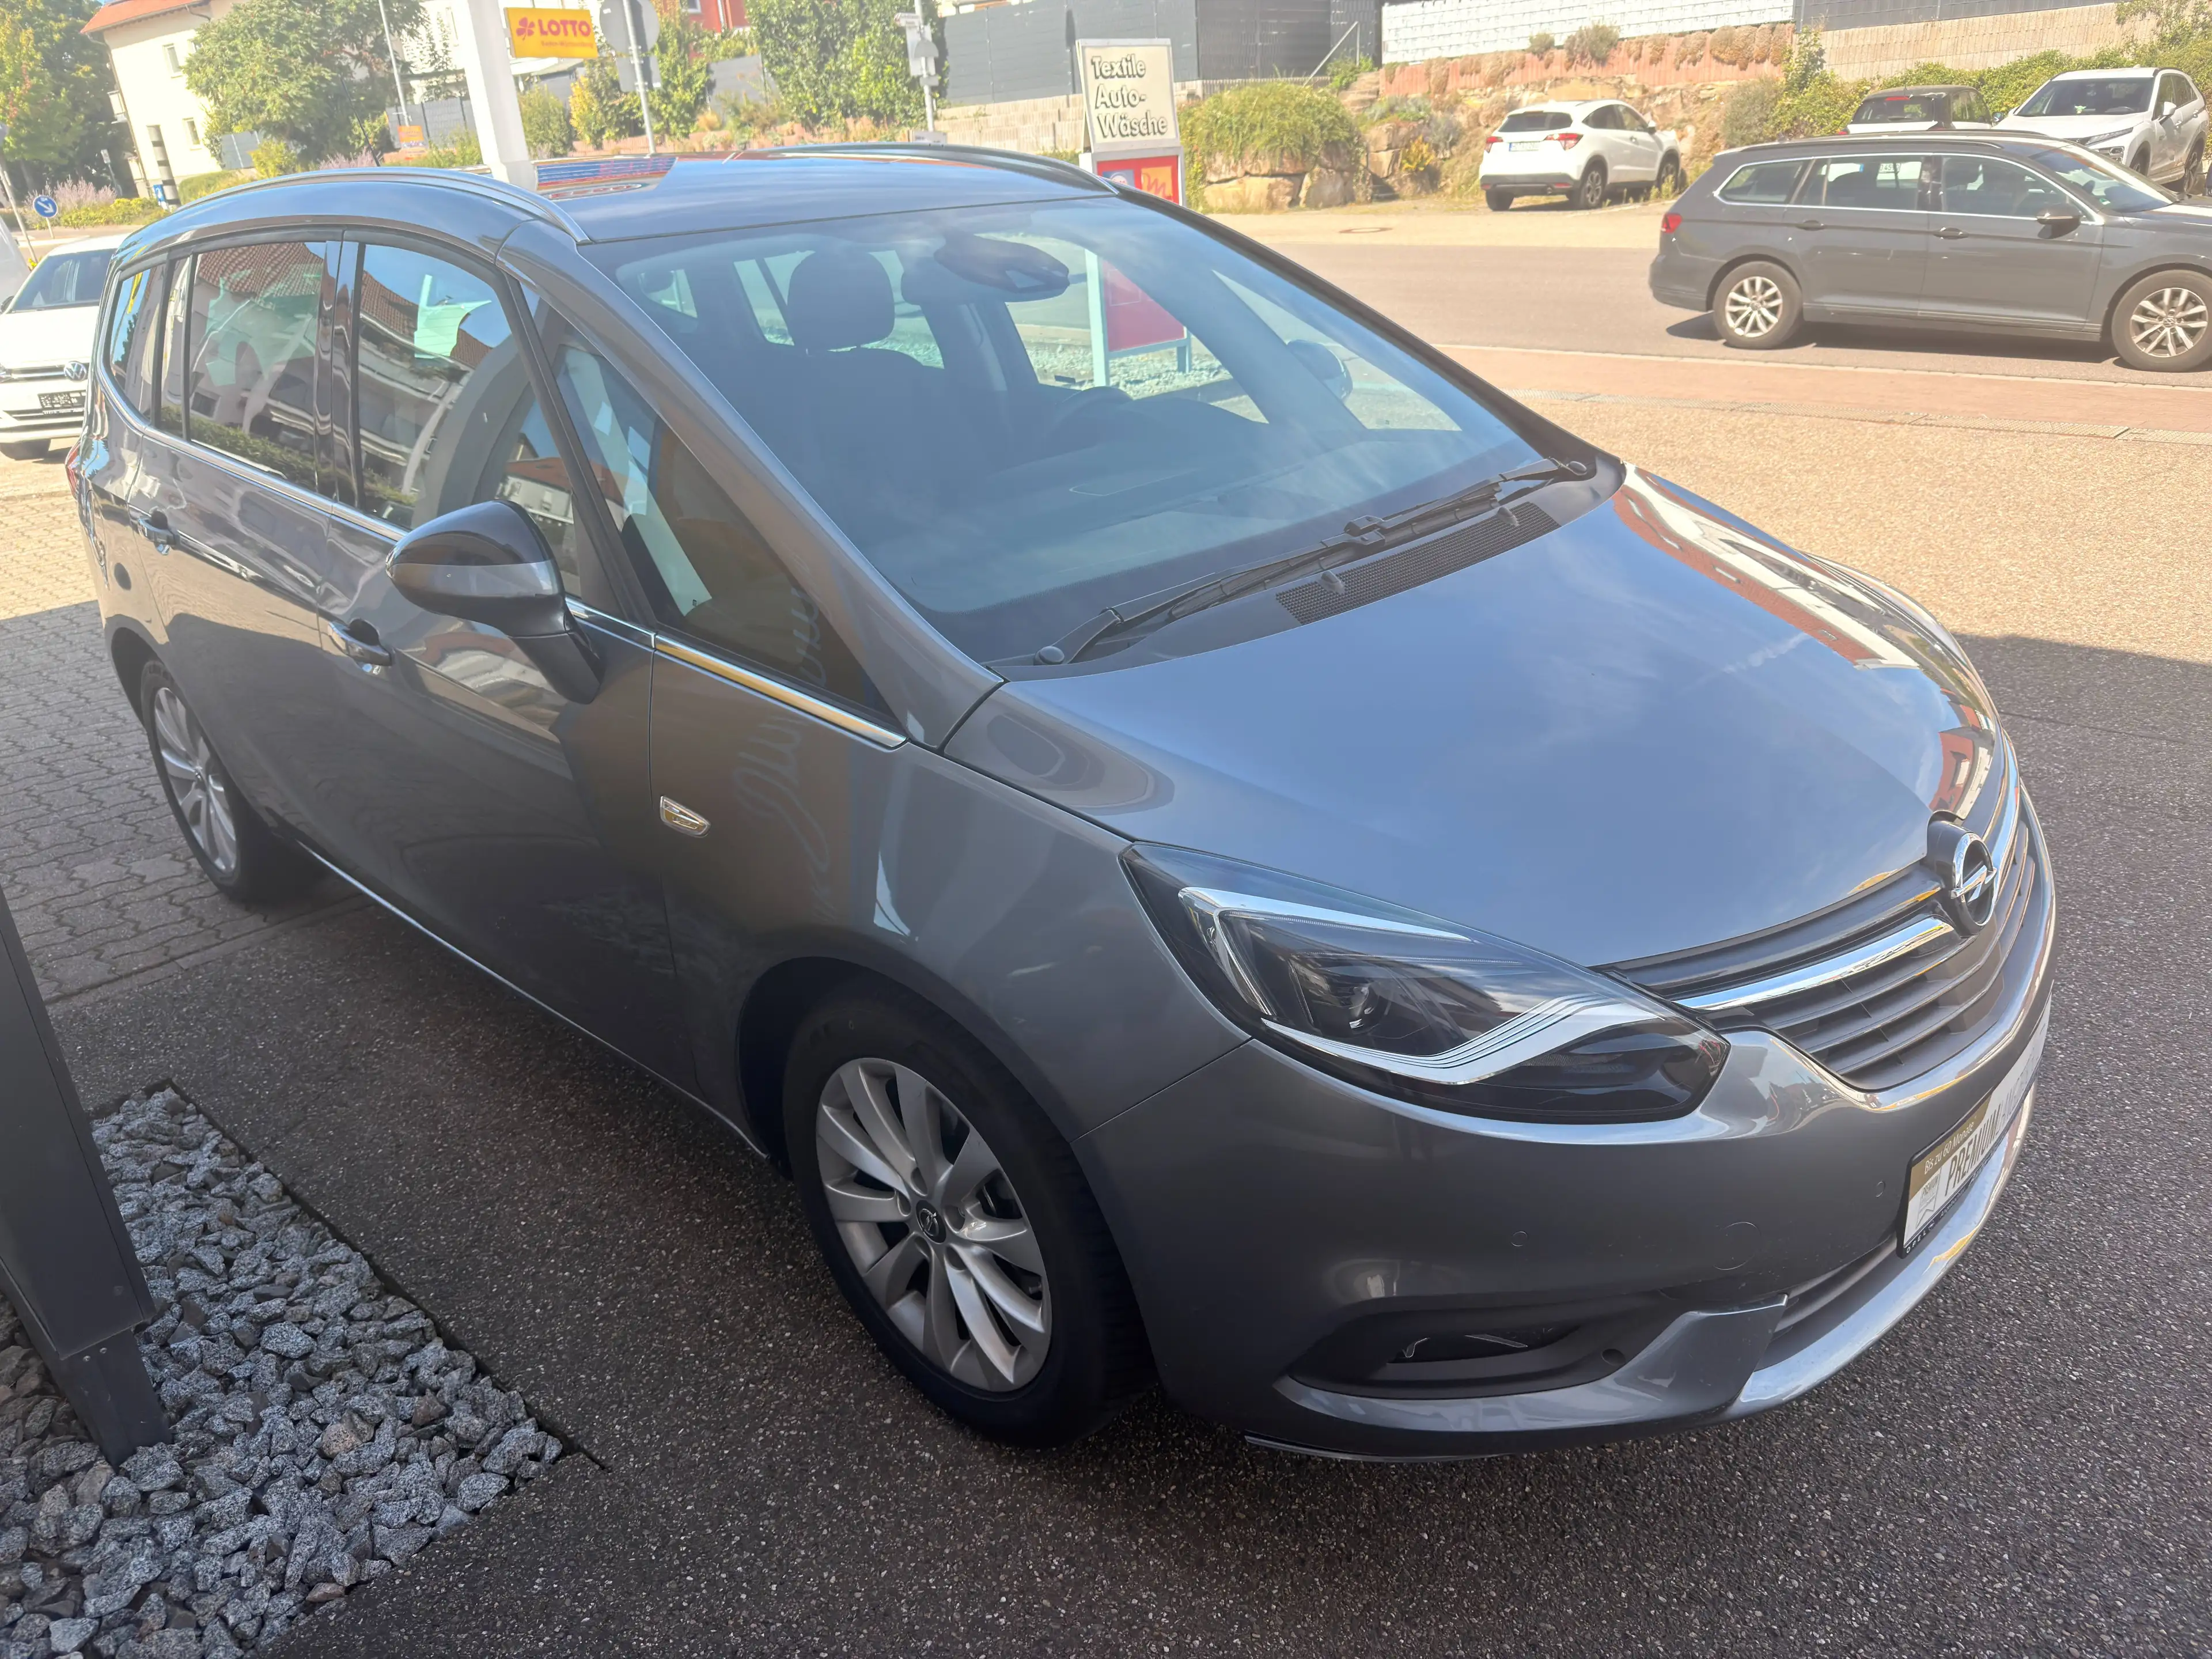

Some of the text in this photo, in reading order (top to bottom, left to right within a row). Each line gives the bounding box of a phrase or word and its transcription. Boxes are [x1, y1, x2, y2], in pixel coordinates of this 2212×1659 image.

[537, 18, 592, 37] LOTTO
[1091, 54, 1146, 79] Textile
[1095, 84, 1147, 109] Auto-
[1097, 109, 1168, 138] Wäsche
[1924, 1122, 1974, 1175] Bis zu 60 Monate
[1906, 1230, 1927, 1254] OPEL
